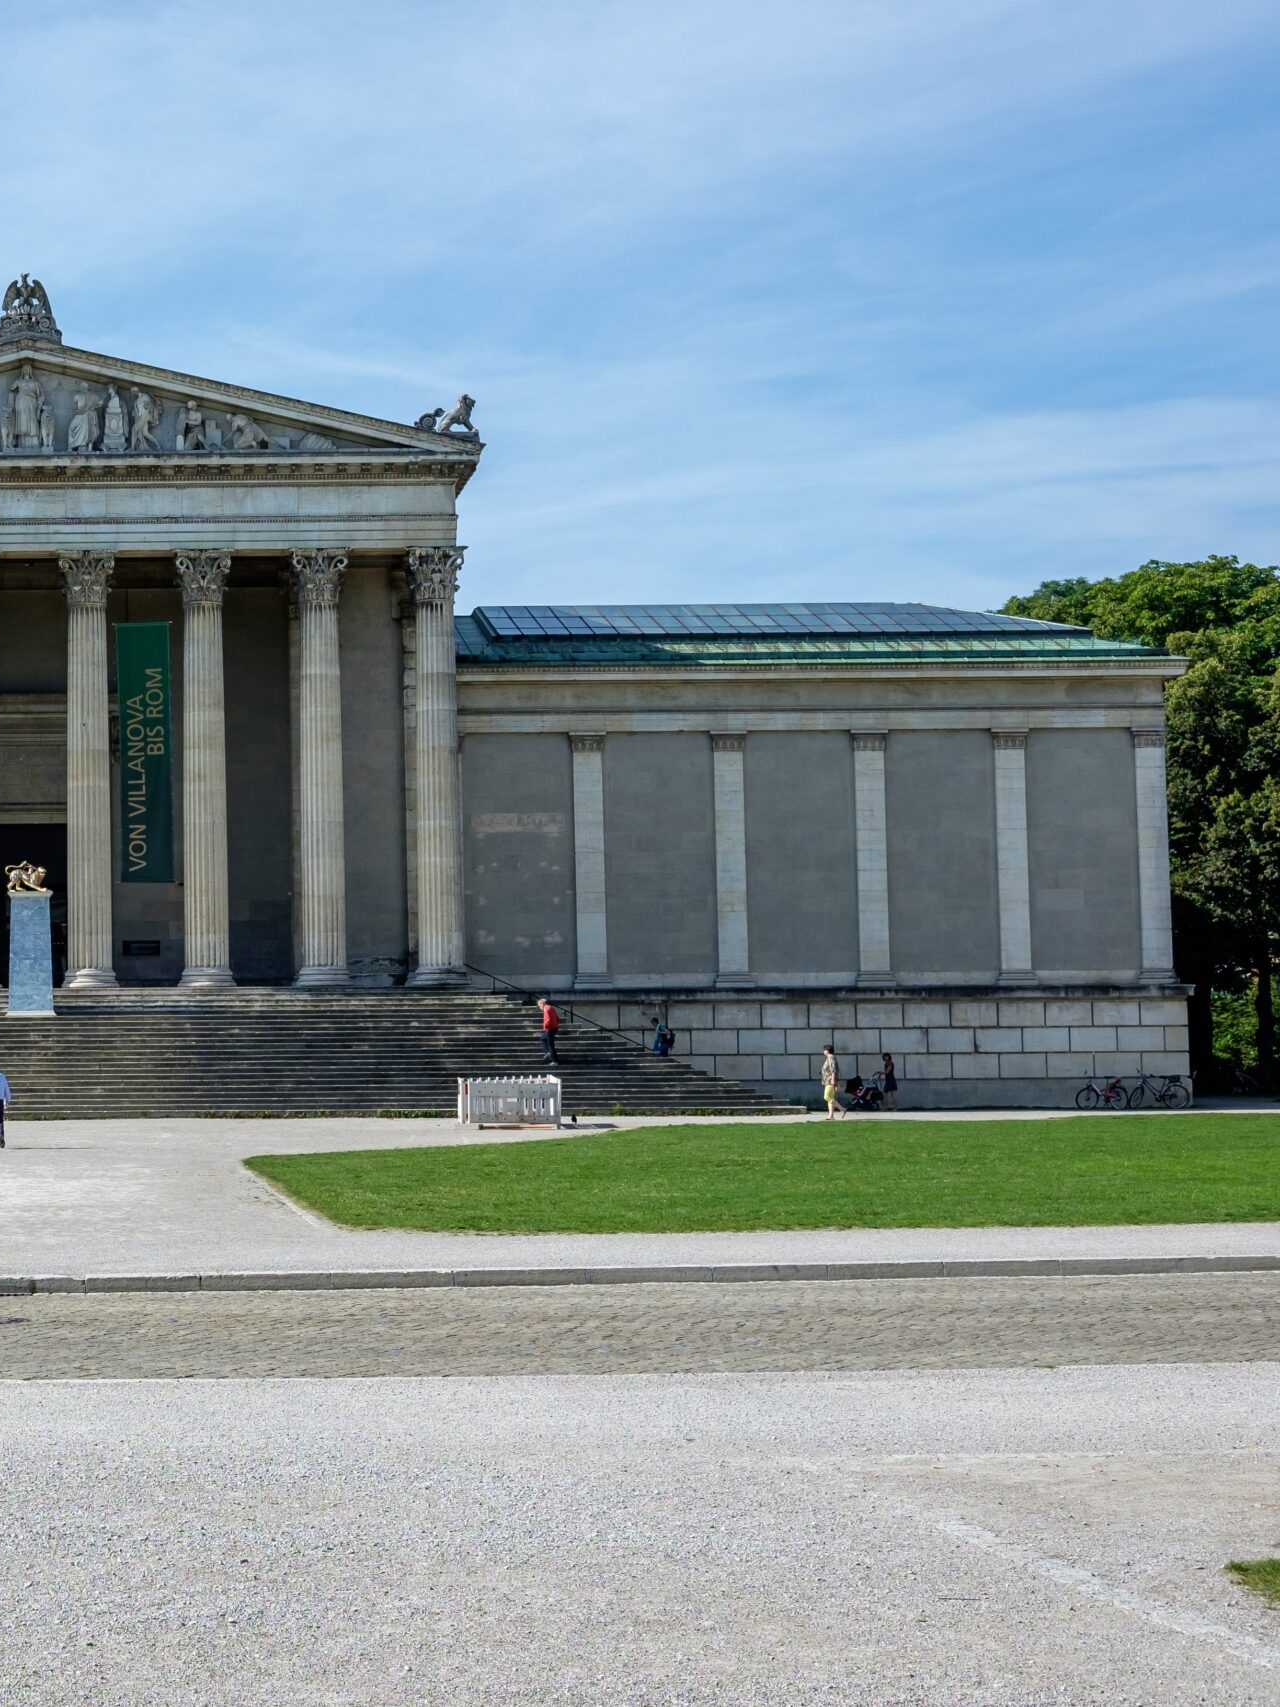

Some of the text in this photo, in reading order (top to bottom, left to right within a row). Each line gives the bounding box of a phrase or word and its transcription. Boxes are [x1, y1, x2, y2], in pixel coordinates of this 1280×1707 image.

[145, 667, 164, 755] BIS ROM
[126, 694, 147, 872] VON VILLANOVA
